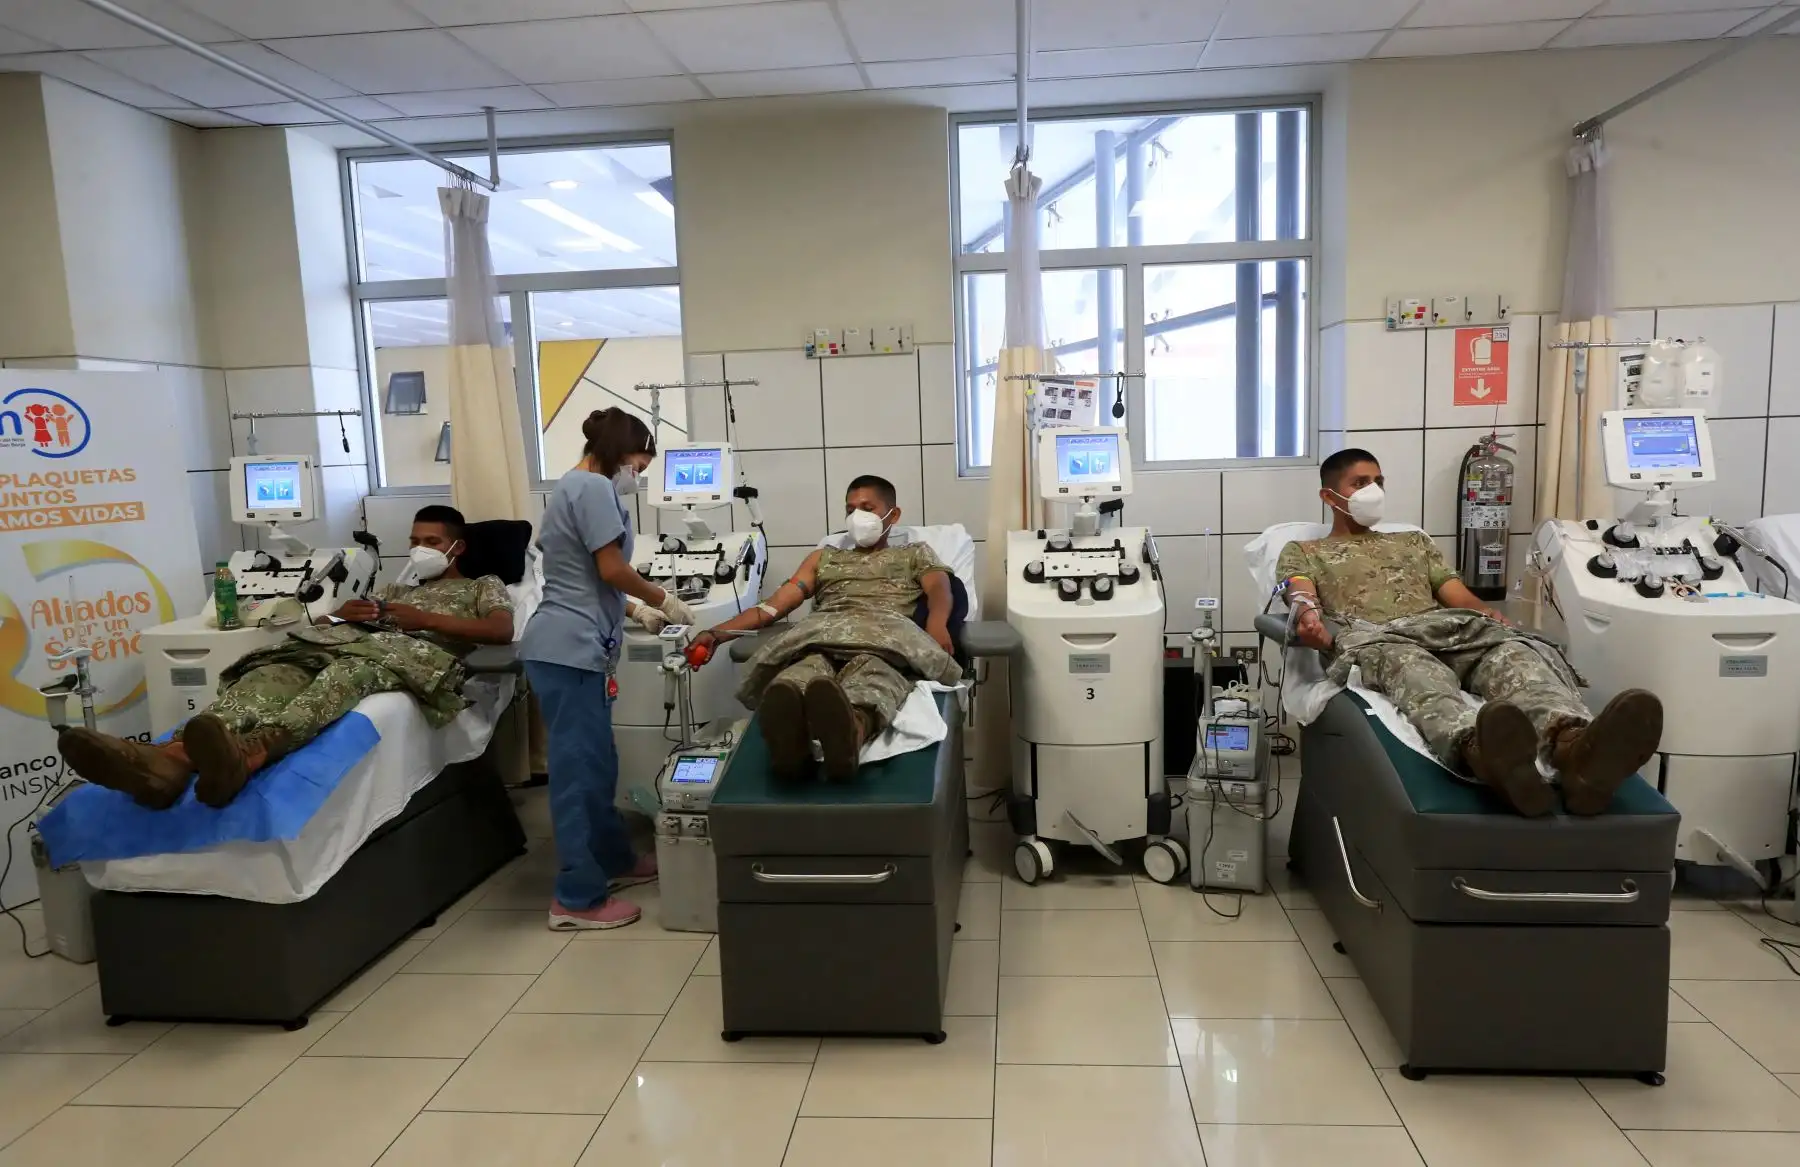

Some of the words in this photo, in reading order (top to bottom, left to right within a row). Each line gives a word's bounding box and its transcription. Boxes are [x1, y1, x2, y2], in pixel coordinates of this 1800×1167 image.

[0, 468, 137, 489] PLAQUETAS
[68, 505, 139, 523] VIDAS
[31, 591, 151, 630] Aliados
[62, 622, 98, 642] por
[104, 618, 129, 632] un
[1086, 687, 1095, 700] 3
[187, 699, 196, 711] 5
[0, 755, 57, 779] anco
[2, 772, 61, 801] INSN
